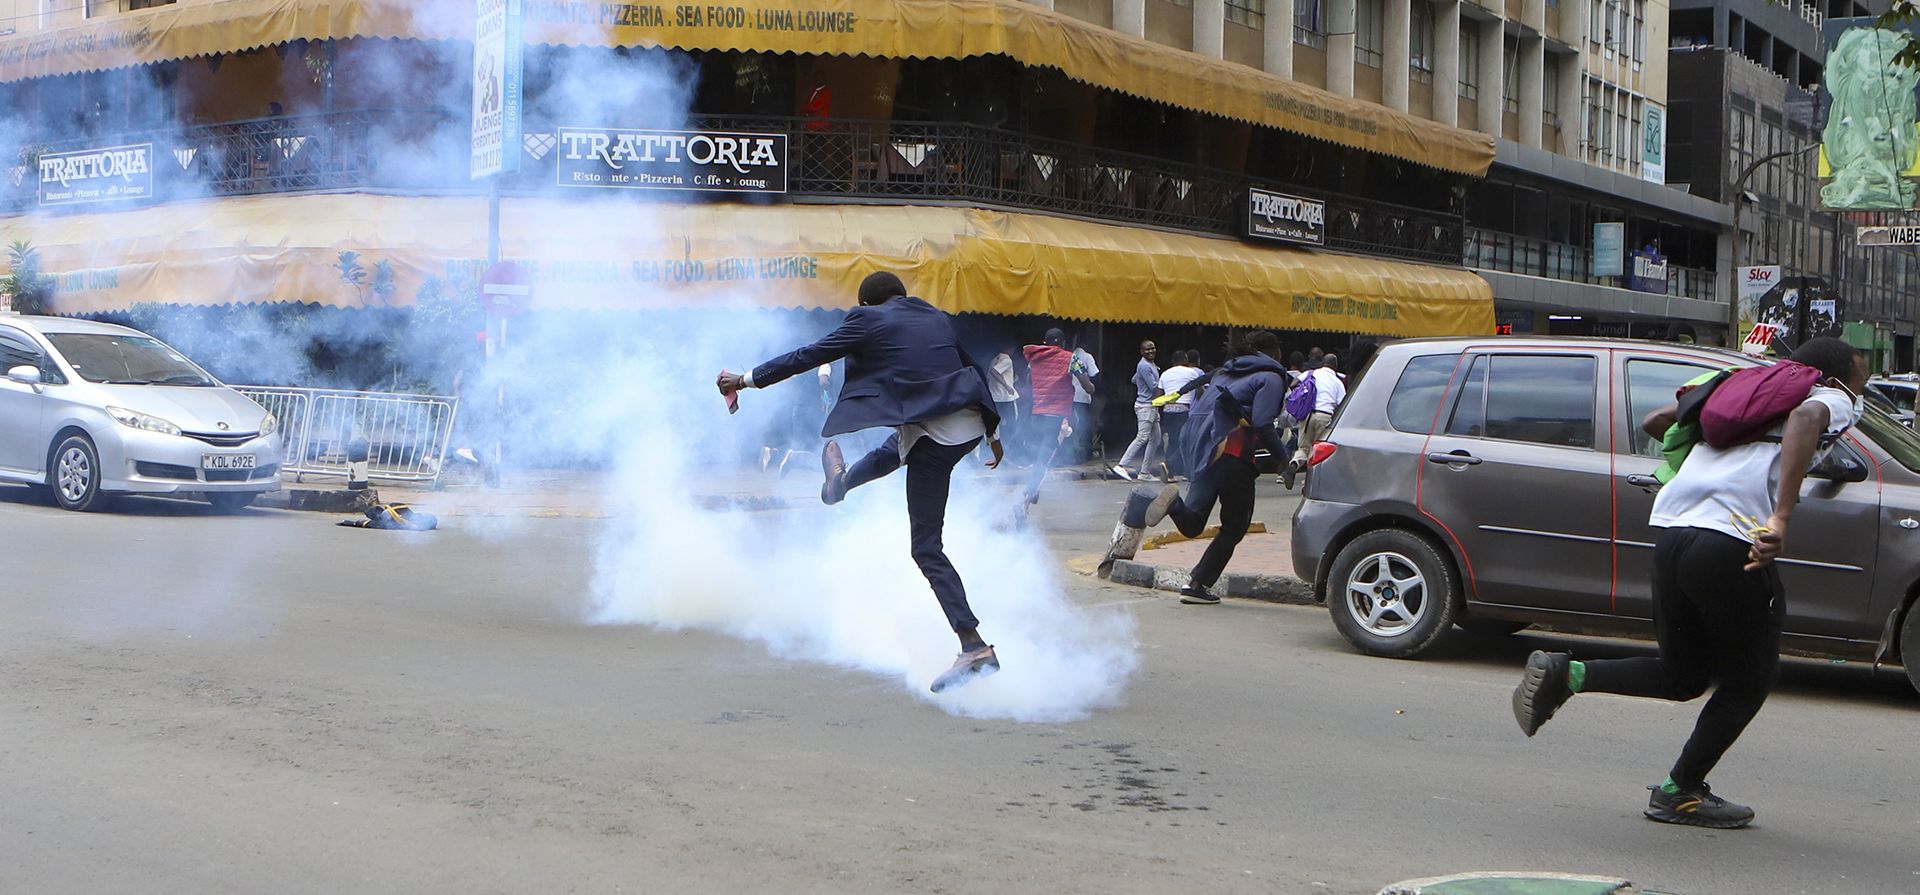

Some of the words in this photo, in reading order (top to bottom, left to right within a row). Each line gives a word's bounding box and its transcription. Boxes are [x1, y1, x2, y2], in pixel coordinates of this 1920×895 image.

[600, 4, 664, 26] PIZZERIA
[676, 5, 703, 27] SEA
[707, 6, 745, 28] FOOD
[756, 9, 794, 31] LUNA
[798, 10, 855, 33] LOUNGE
[562, 132, 779, 174] TRATTORIA
[40, 149, 148, 188] TRATTORIA
[573, 171, 630, 183] Rstonte
[640, 173, 683, 184] Pizzeria
[694, 174, 721, 185] Cffe
[733, 176, 769, 189] oung
[1252, 192, 1324, 230] TRATTORIA
[1890, 227, 1920, 244] WABE
[88, 268, 119, 290] LOUNGE
[632, 260, 660, 283] SEA
[665, 258, 705, 283] FOOD
[716, 256, 755, 281] LUNA
[760, 254, 817, 280] LOUNGE
[1748, 268, 1772, 281] Sky
[212, 456, 229, 468] KDL
[231, 456, 254, 468] 692E
